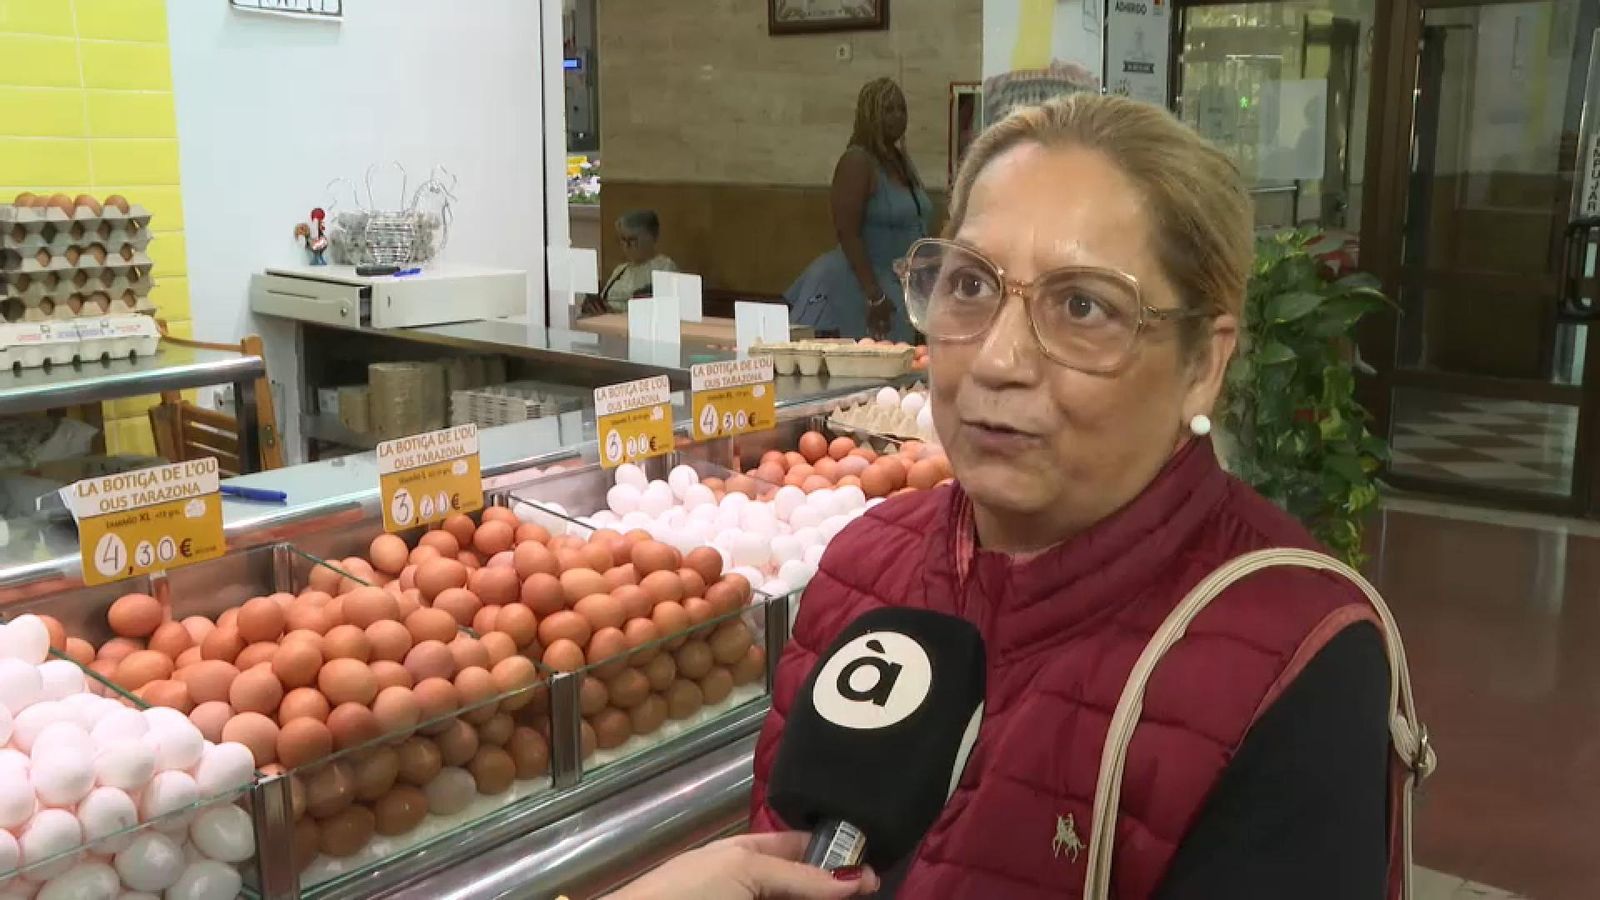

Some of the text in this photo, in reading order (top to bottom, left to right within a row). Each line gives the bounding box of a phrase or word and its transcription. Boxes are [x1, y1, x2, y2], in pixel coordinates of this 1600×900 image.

[693, 366, 705, 377] LA
[706, 362, 738, 375] BOTIGA
[721, 373, 763, 386] TARAZONA
[597, 388, 606, 401] LA
[608, 383, 637, 399] BOTIGA
[380, 425, 476, 458] LA BOTIGA DE L'OU
[394, 445, 466, 469] OUS TARAZONA
[78, 460, 216, 498] LA BOTIGA DE L'OU
[100, 481, 200, 512] OUS TARAZONA
[139, 512, 151, 521] XL
[836, 639, 903, 707] à
